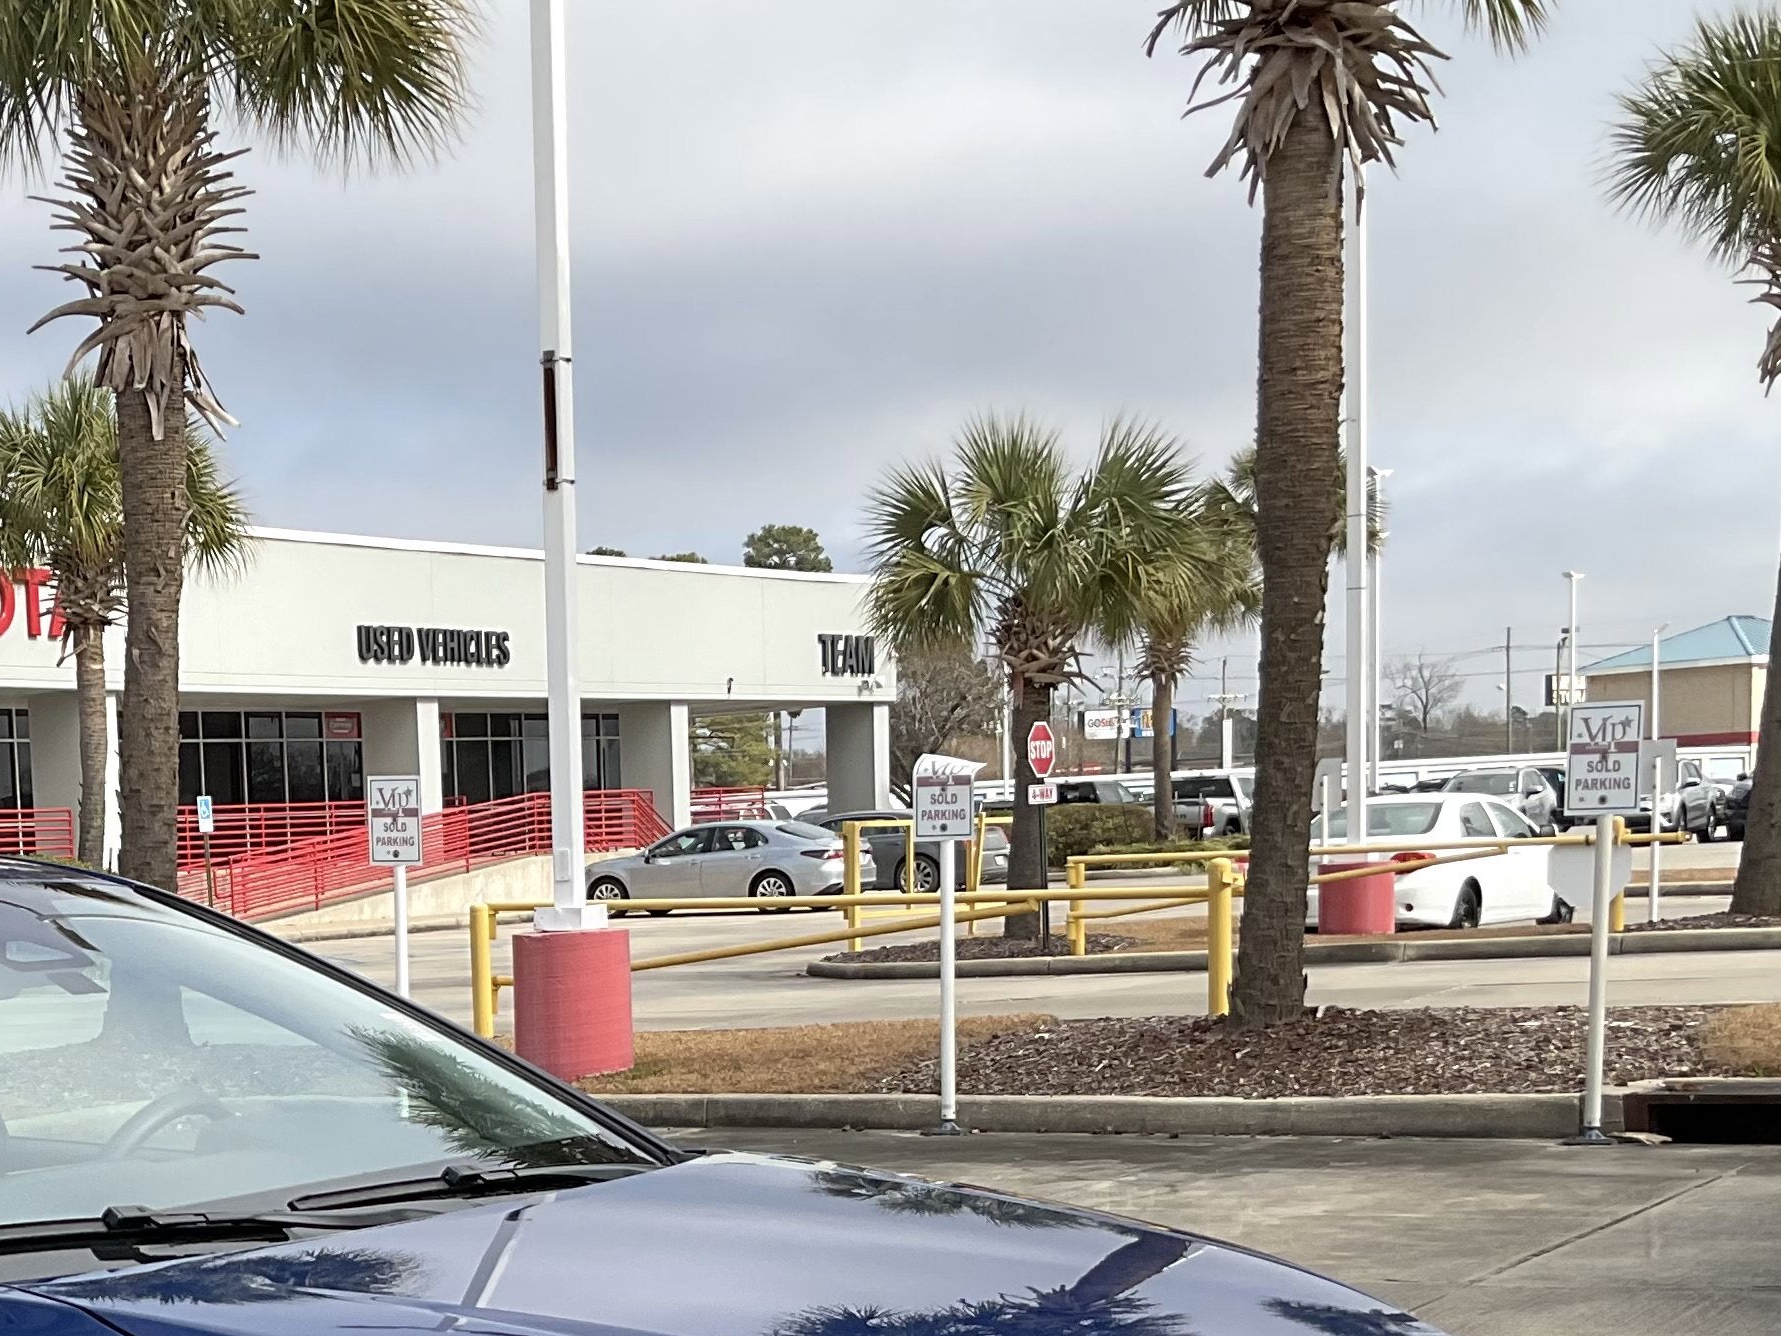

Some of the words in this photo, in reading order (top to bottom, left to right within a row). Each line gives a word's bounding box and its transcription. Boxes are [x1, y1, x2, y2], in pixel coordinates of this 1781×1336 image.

[356, 625, 415, 663] USED
[416, 628, 511, 667] VEHICLES
[818, 634, 876, 675] TEAM
[1030, 740, 1053, 760] STOP
[1586, 760, 1621, 773] SOLD
[1575, 777, 1631, 791] PARKING
[930, 793, 958, 804] SOLD
[1031, 788, 1053, 800] 4-WAY
[921, 808, 966, 821] PARKING
[383, 822, 407, 832] SOLD
[376, 836, 415, 847] PARKING
